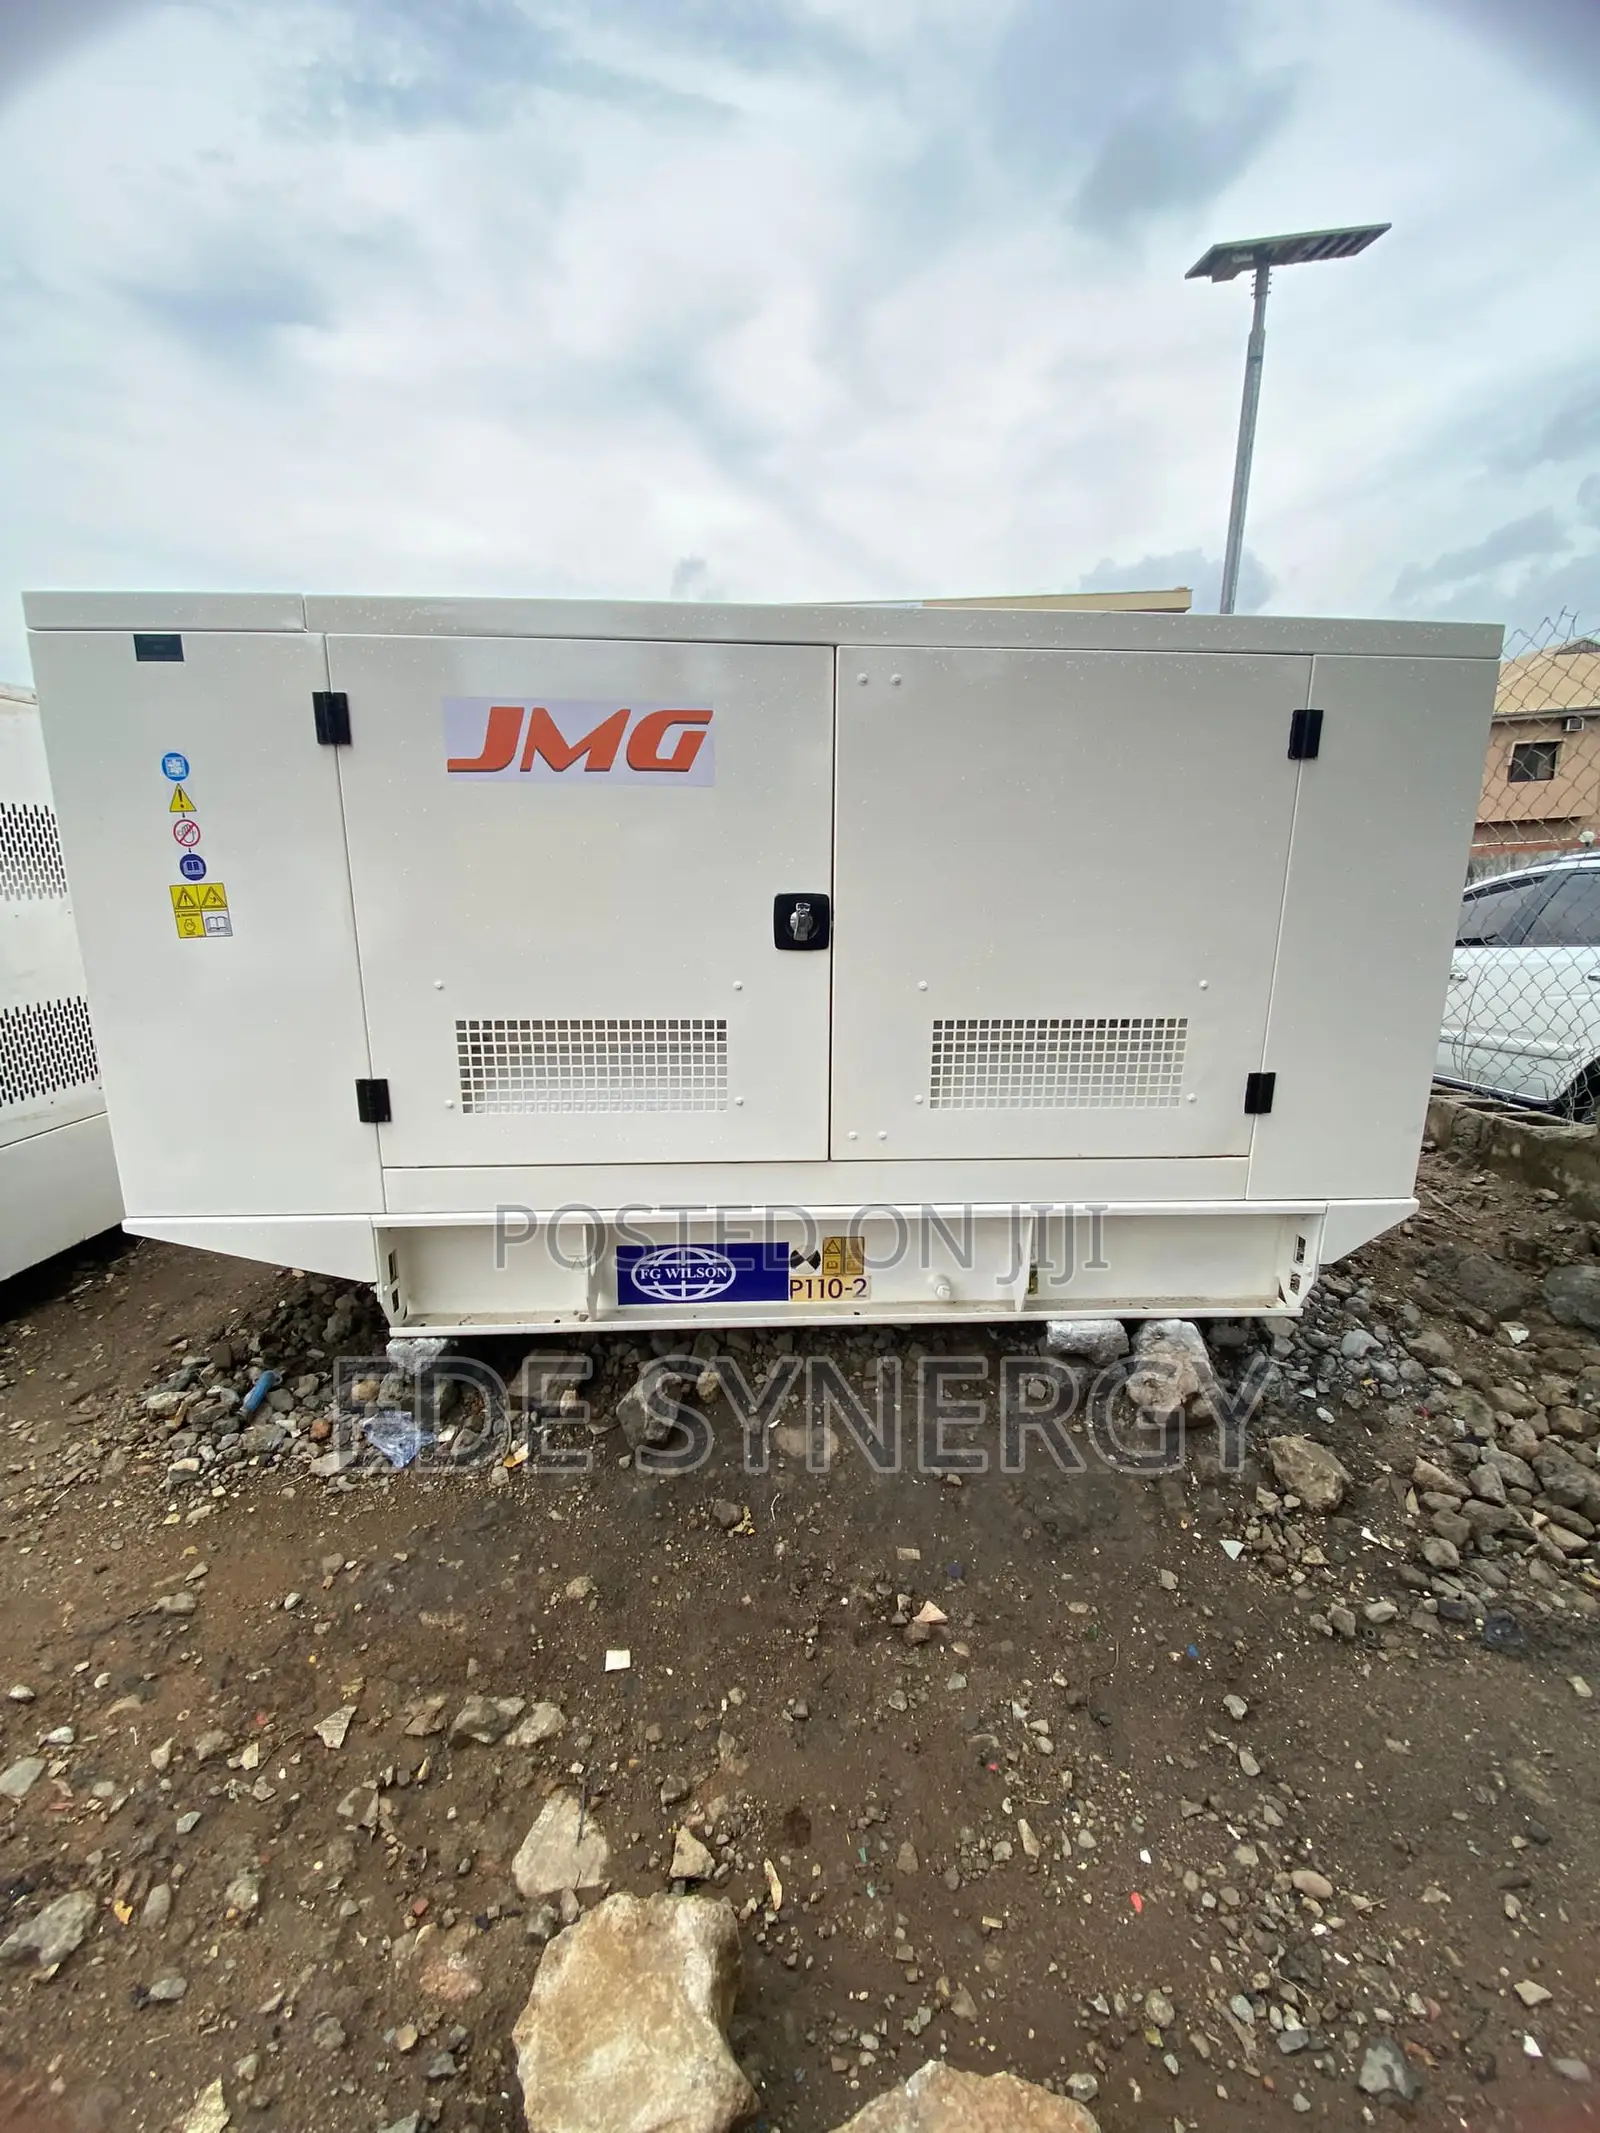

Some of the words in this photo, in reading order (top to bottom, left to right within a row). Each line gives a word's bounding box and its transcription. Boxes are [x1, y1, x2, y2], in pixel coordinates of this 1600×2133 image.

[447, 706, 714, 773] JMG
[640, 1267, 662, 1280] FG
[664, 1266, 728, 1280] WILSON
[789, 1278, 868, 1300] P110-2
